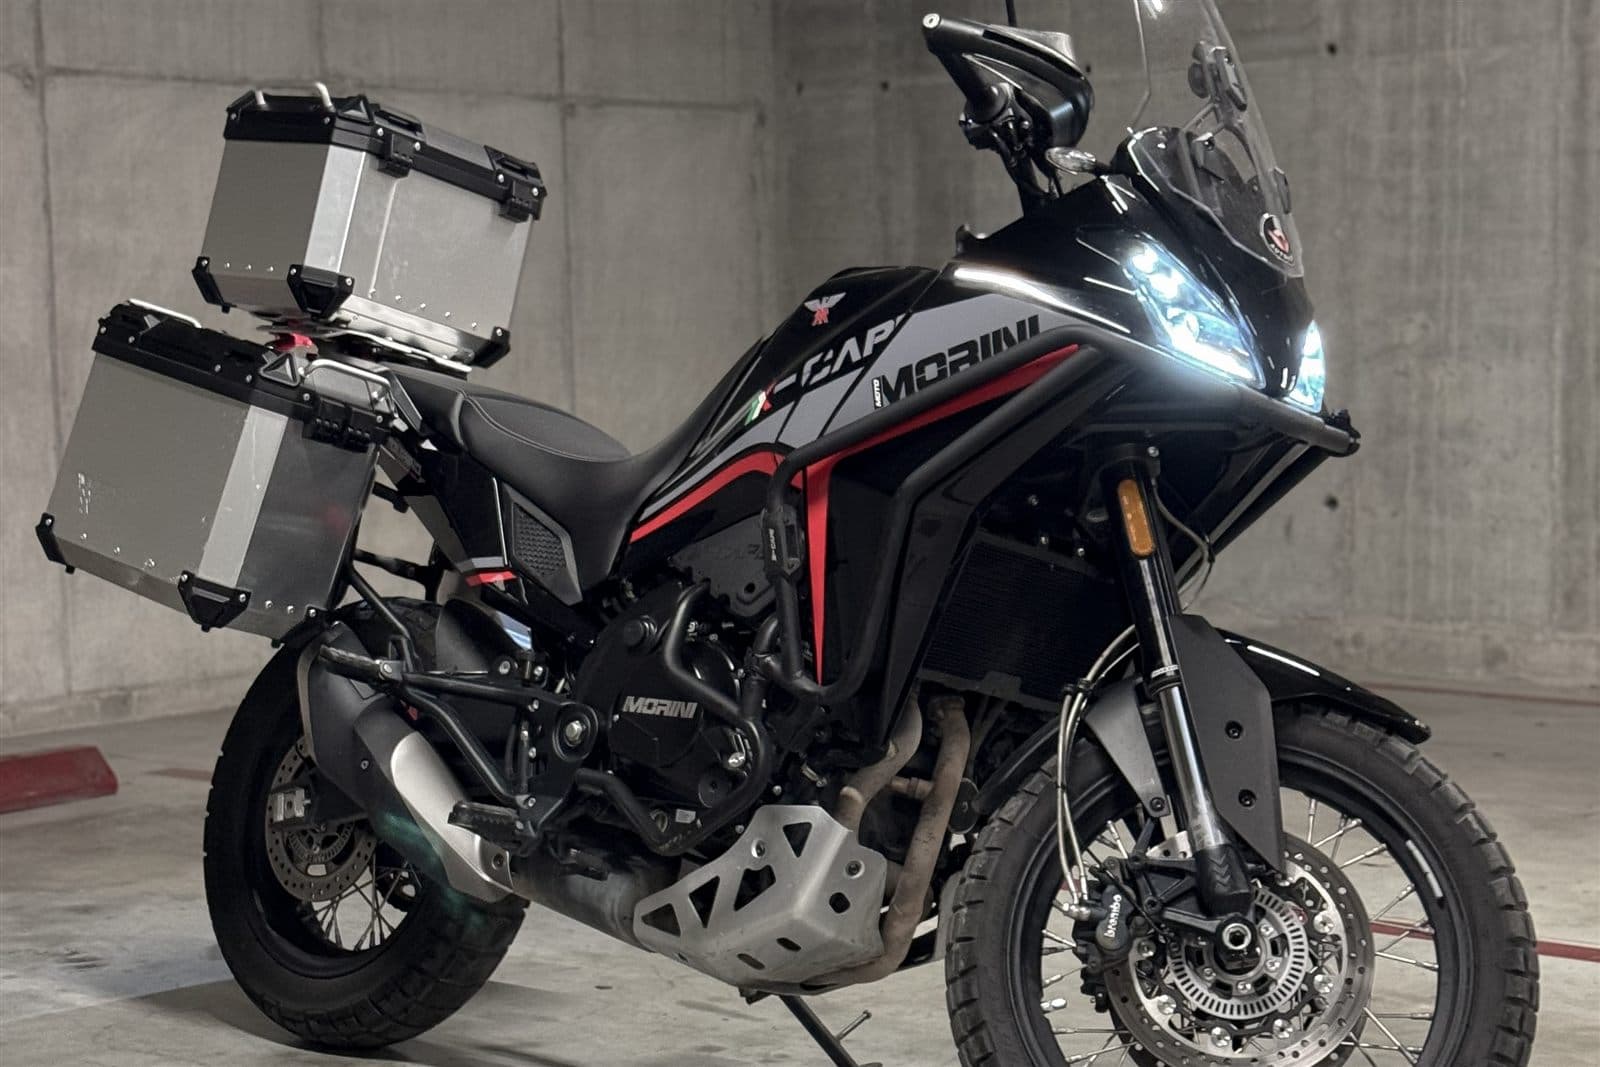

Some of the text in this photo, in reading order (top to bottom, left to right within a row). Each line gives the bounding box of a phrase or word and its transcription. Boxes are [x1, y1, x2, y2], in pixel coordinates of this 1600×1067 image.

[882, 315, 1040, 405] MORINI
[872, 378, 883, 408] MOTO
[622, 696, 698, 719] MORINI
[1103, 894, 1122, 938] brembo
